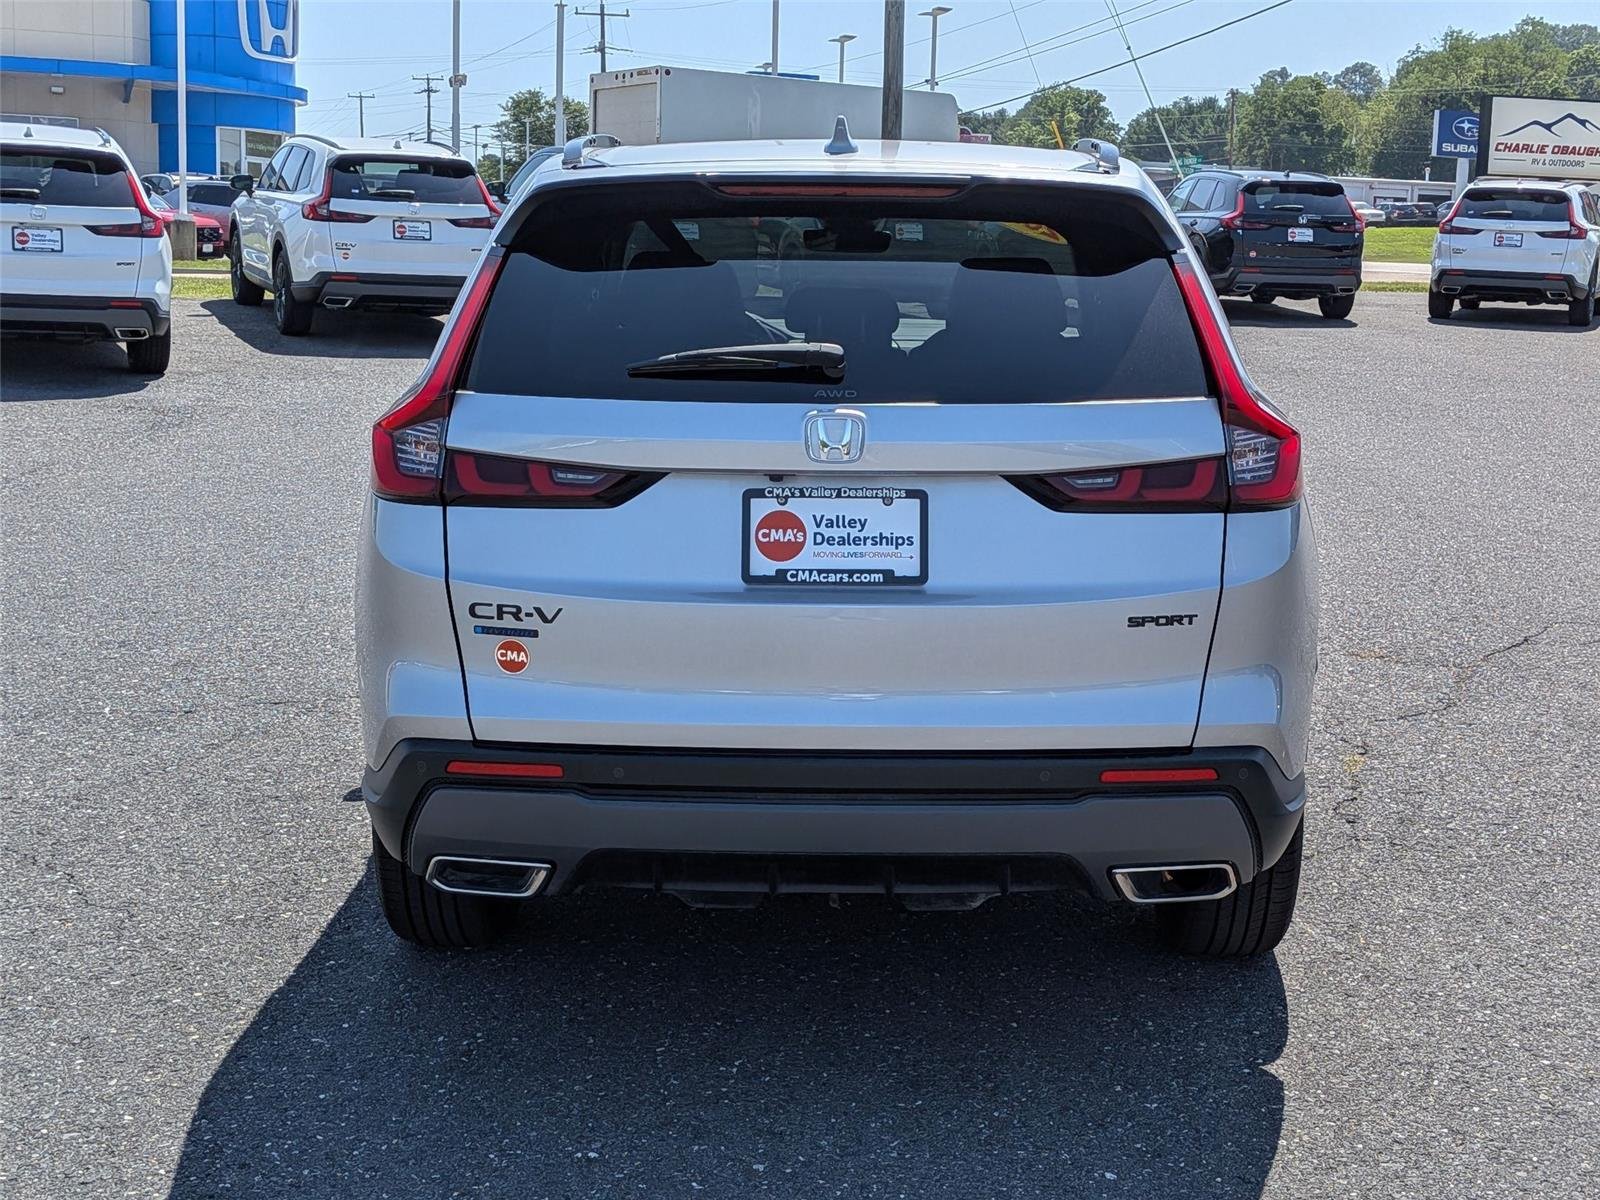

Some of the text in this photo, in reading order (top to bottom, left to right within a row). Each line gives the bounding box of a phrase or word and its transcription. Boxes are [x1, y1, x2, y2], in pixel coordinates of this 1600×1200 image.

[1442, 143, 1478, 153] SUBA
[1494, 142, 1549, 155] CHARLIE
[1531, 158, 1541, 166] RV
[1548, 159, 1585, 168] OUTDOORS
[814, 390, 857, 398] AWD
[765, 487, 906, 498] CMA's Valley Dealerships
[812, 514, 868, 532] Valley
[758, 528, 804, 542] CMA's
[812, 532, 914, 549] Dealerships
[786, 570, 884, 583] CMAcars.com
[468, 602, 563, 624] CR-V
[1127, 614, 1198, 628] SPORT
[497, 649, 528, 663] CMA
